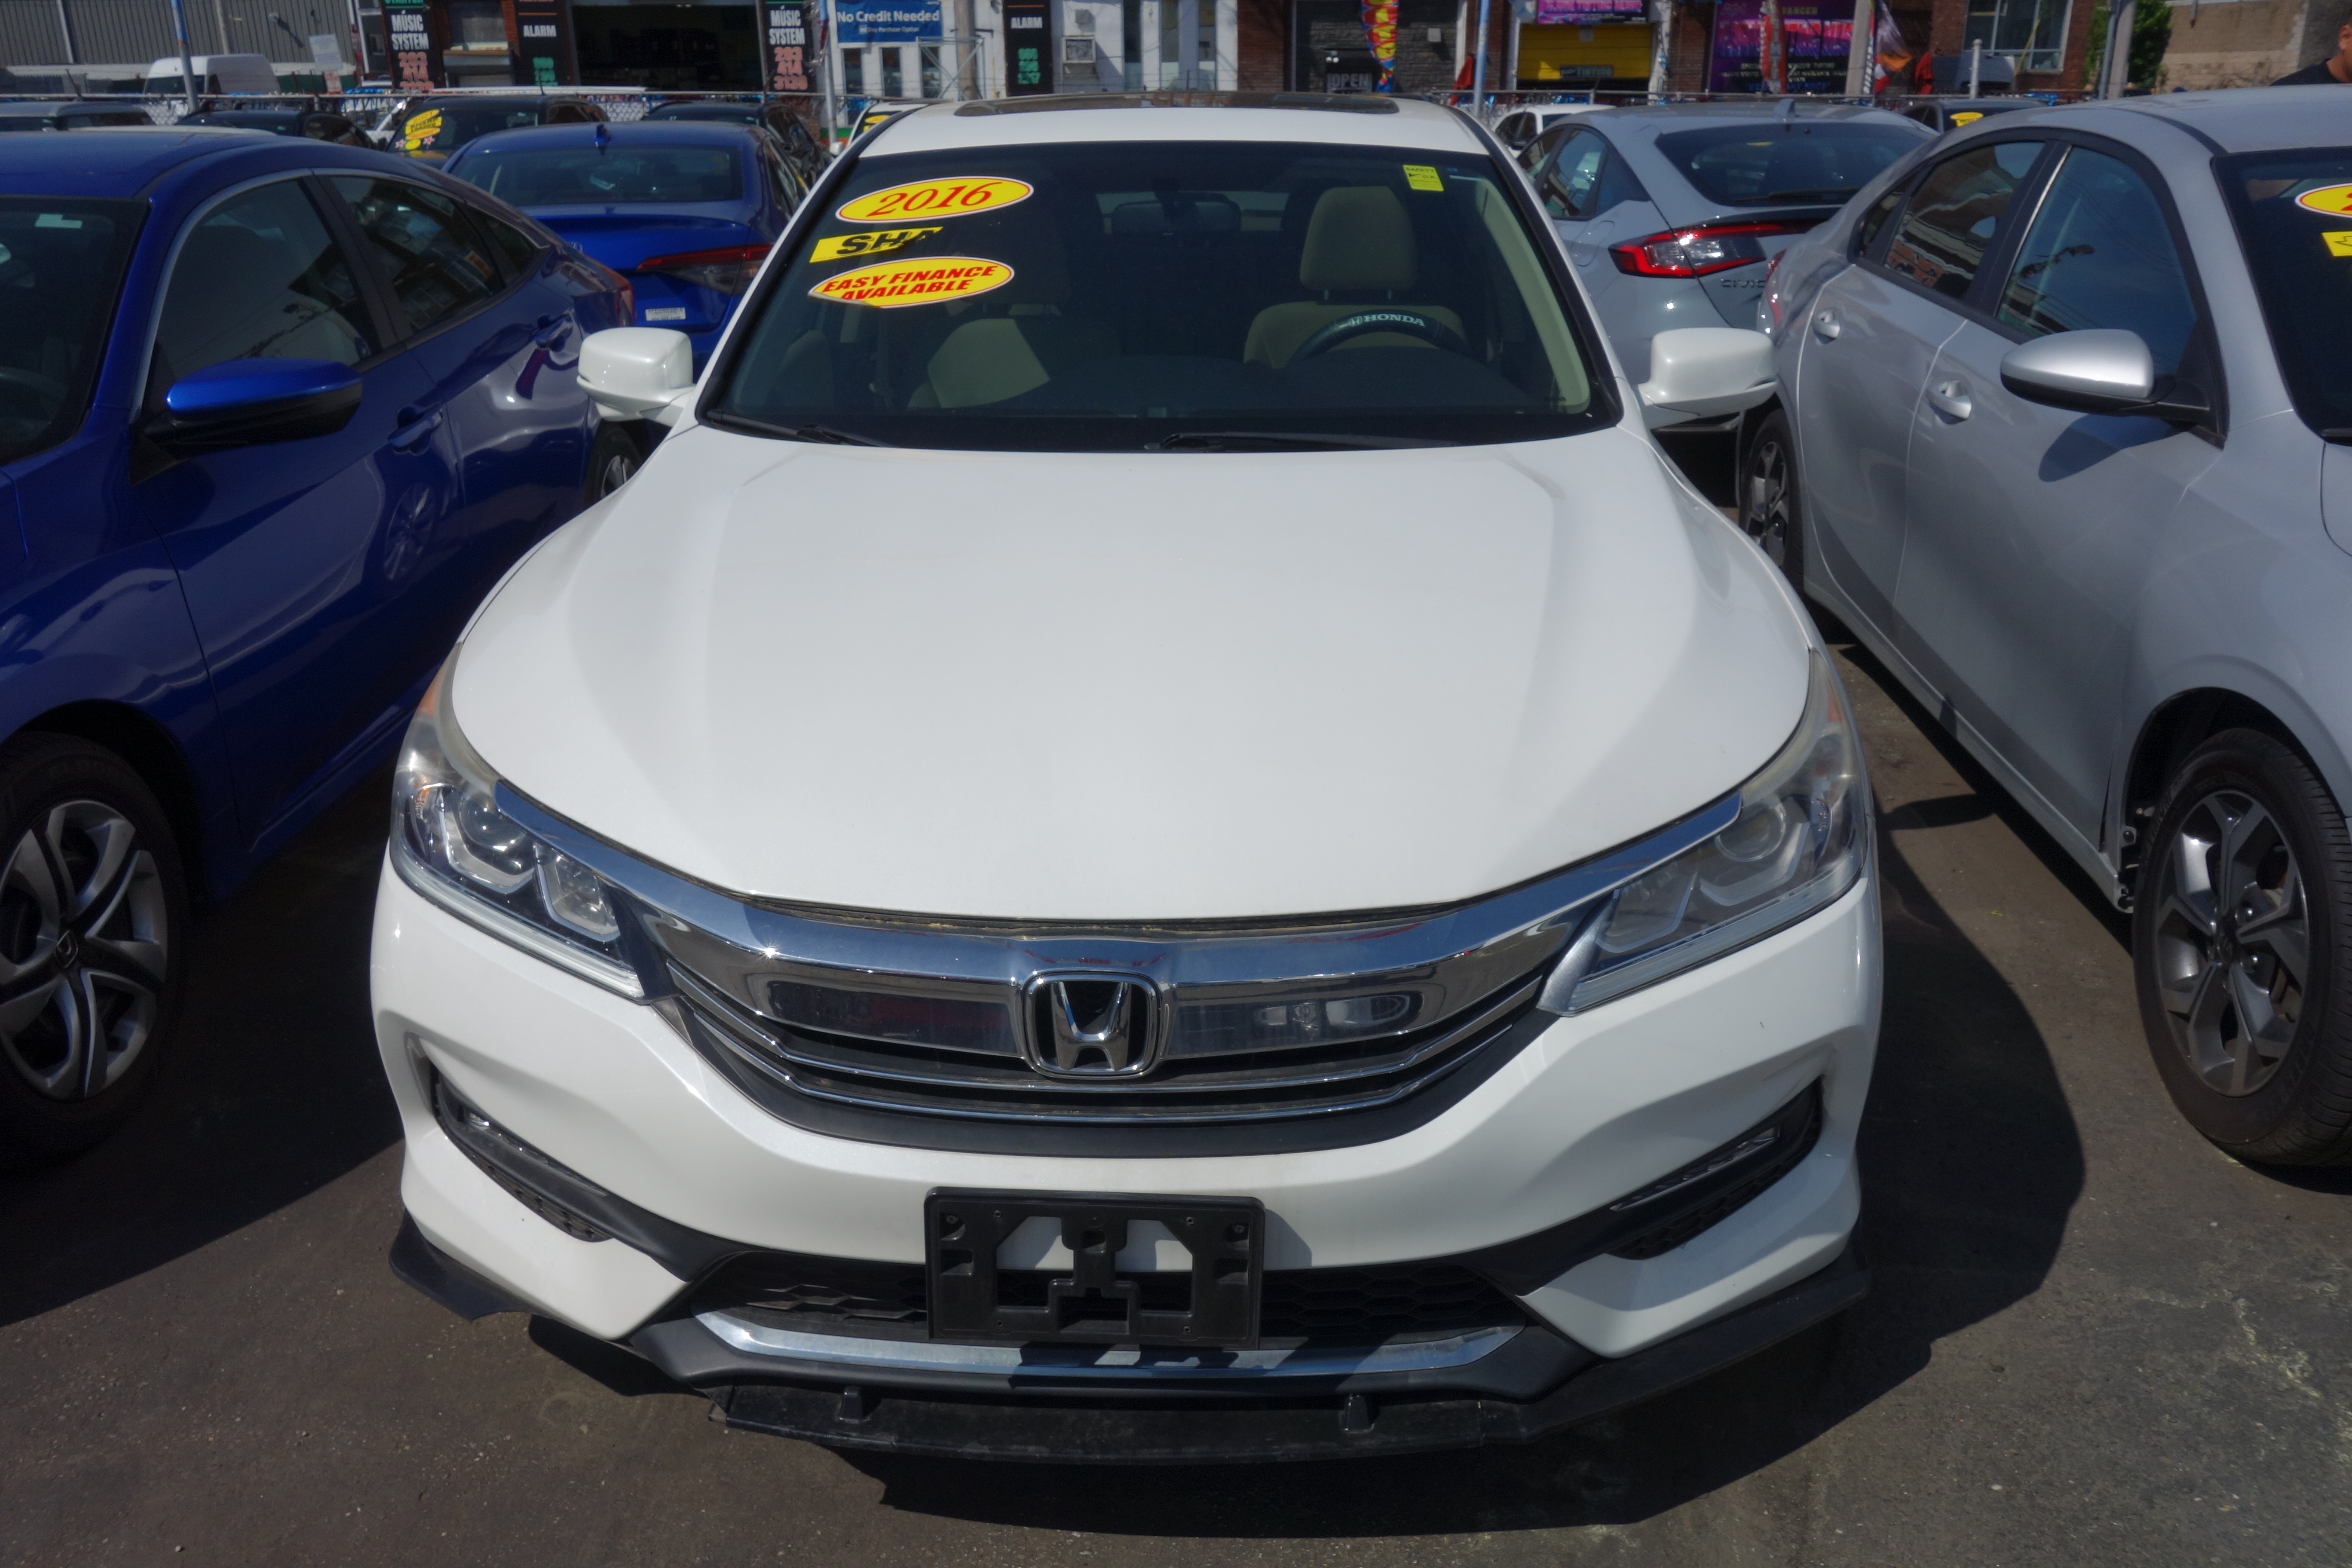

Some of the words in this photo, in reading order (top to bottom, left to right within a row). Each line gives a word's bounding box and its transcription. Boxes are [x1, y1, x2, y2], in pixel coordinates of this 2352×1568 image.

[837, 11, 854, 22] No
[856, 10, 892, 22] Credit
[894, 10, 940, 21] Needed
[1011, 17, 1043, 29] ALARM
[523, 25, 557, 37] ALARM
[769, 28, 805, 45] SYSTEM
[391, 32, 429, 50] SYSTEM
[866, 182, 1002, 217] 2016
[822, 275, 887, 293] EASY
[889, 265, 998, 284] FINANCE
[840, 279, 973, 300] AVAILABLE
[1363, 314, 1426, 327] HONDA
